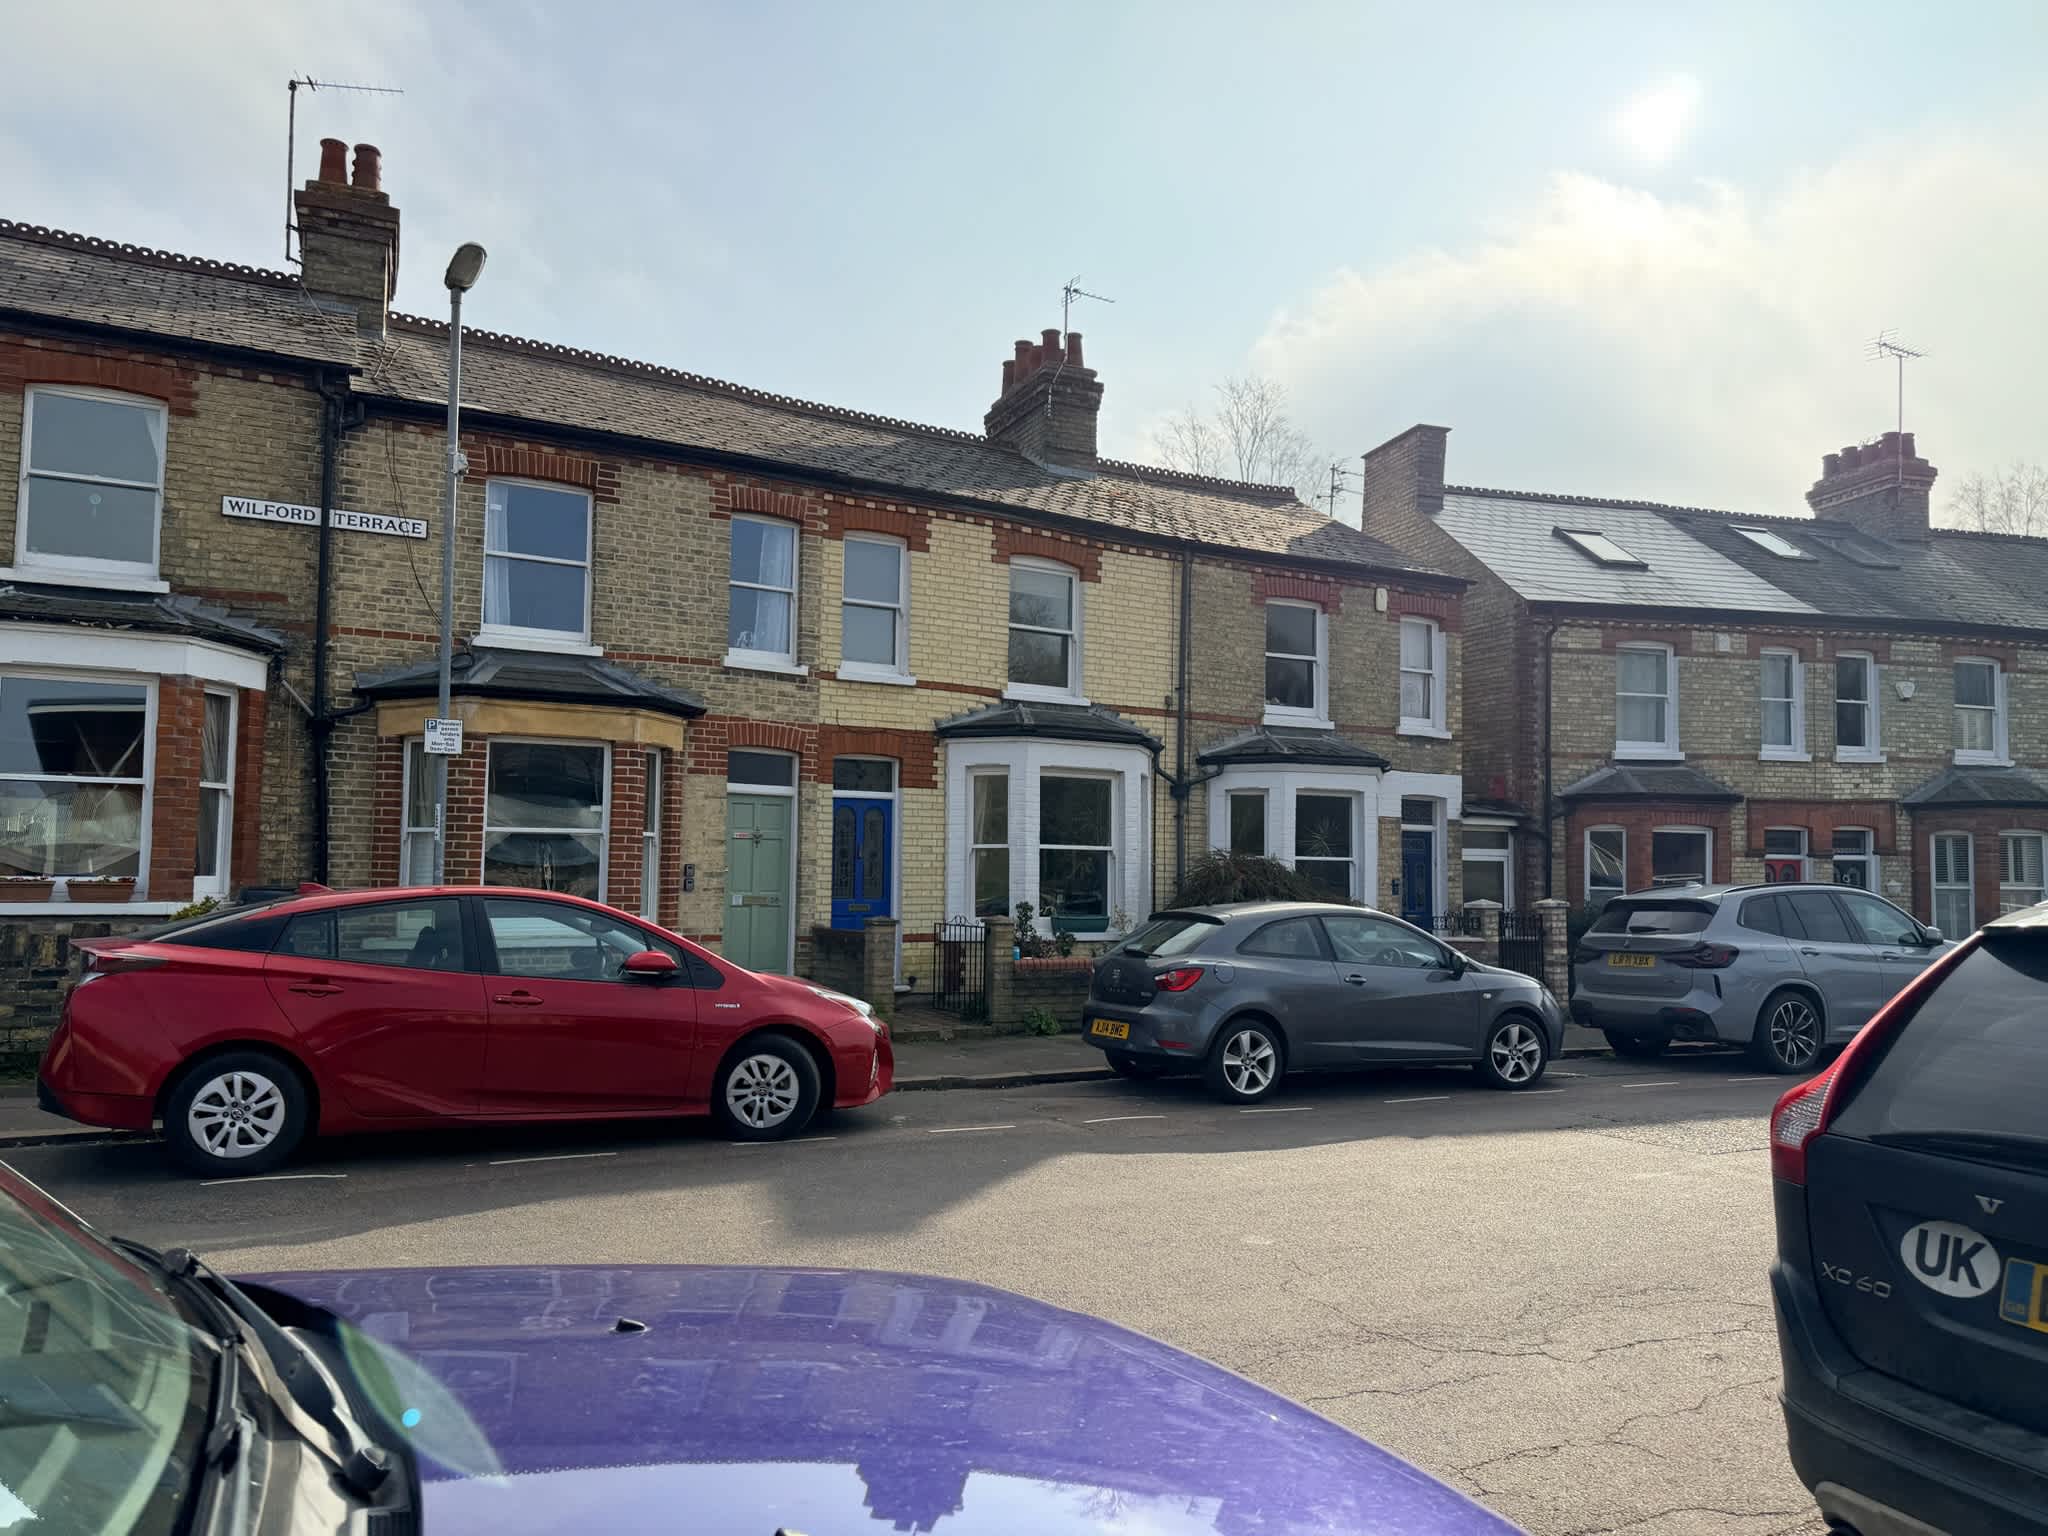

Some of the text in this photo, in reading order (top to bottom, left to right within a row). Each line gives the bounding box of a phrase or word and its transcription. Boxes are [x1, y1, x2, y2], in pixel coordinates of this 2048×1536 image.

[228, 499, 423, 535] WILFORD TERRACE
[428, 720, 436, 729] P
[1915, 1228, 1987, 1290] UK
